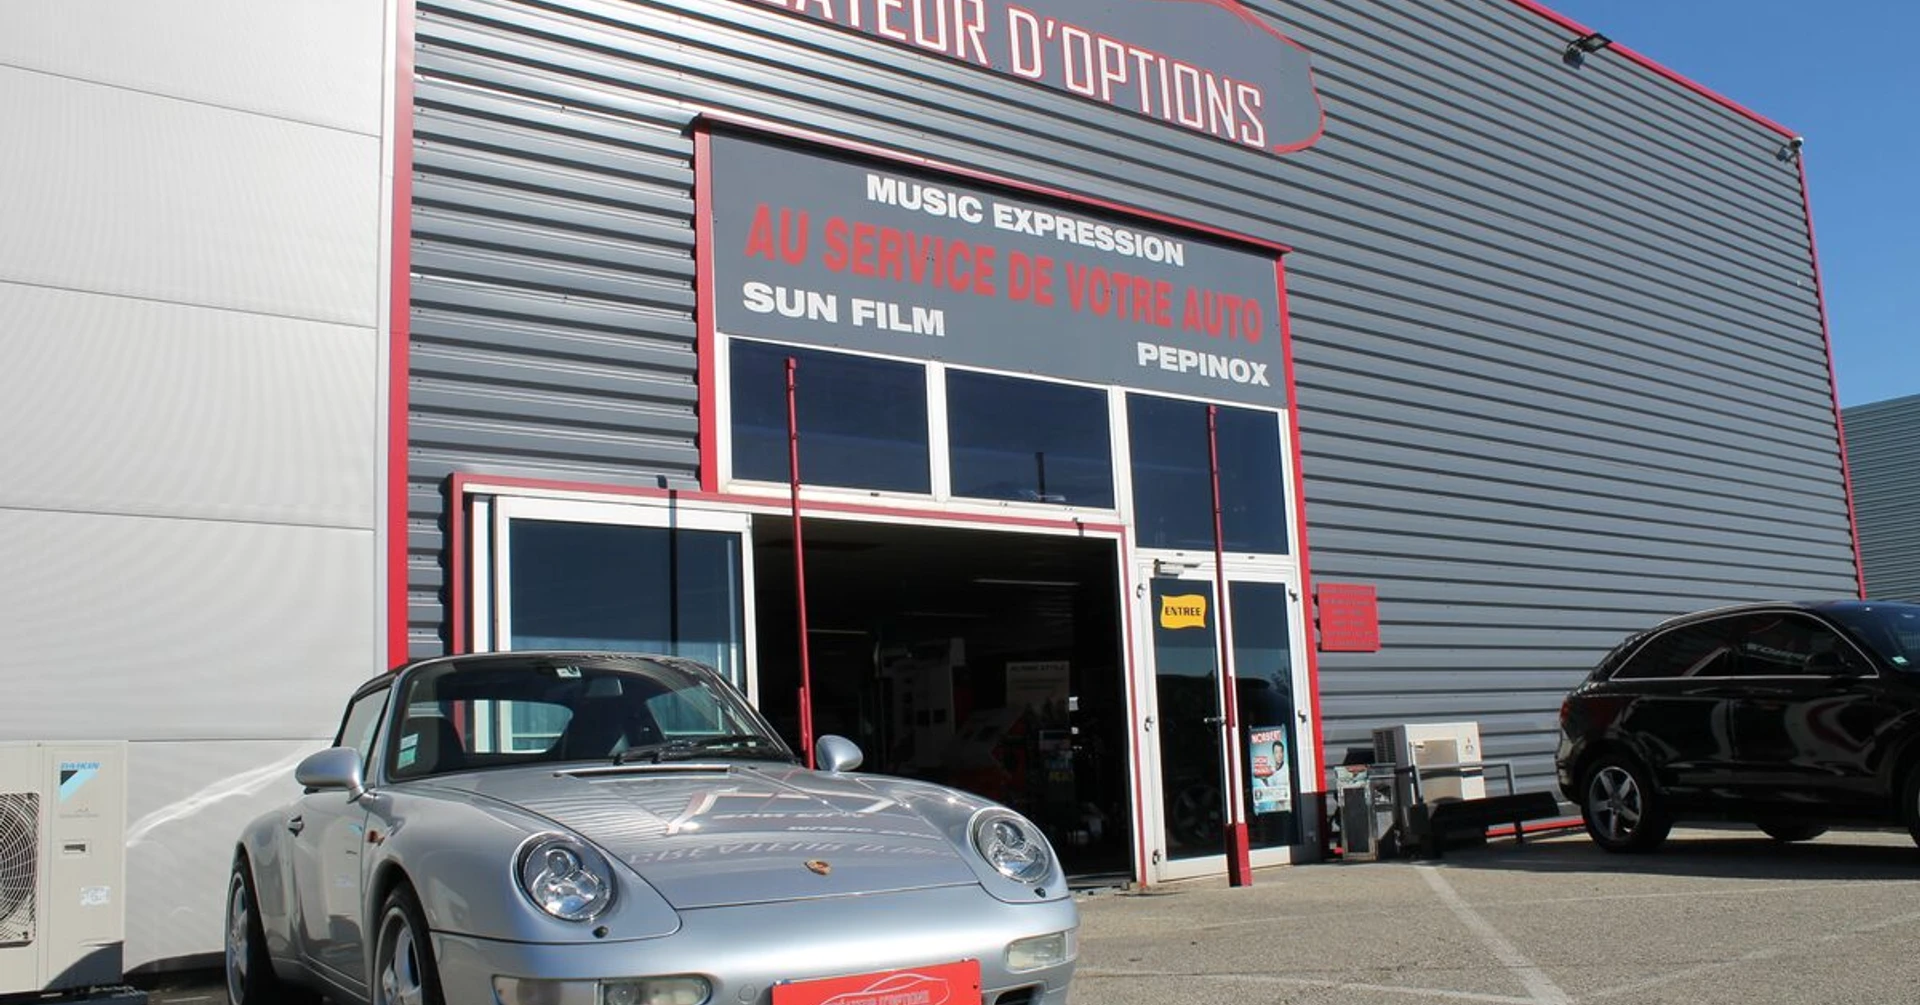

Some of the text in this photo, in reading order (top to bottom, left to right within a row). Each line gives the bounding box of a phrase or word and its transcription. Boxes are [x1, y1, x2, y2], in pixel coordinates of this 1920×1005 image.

[1007, 7, 1266, 149] D'OPTIONS
[866, 173, 1185, 267] MUSIC EXPRESSION
[742, 281, 946, 337] SUN FILM
[744, 203, 1263, 344] AU SERVICE DE VOTRE AUTO
[1136, 341, 1271, 387] PEPINOX
[1164, 606, 1203, 617] ENTREE
